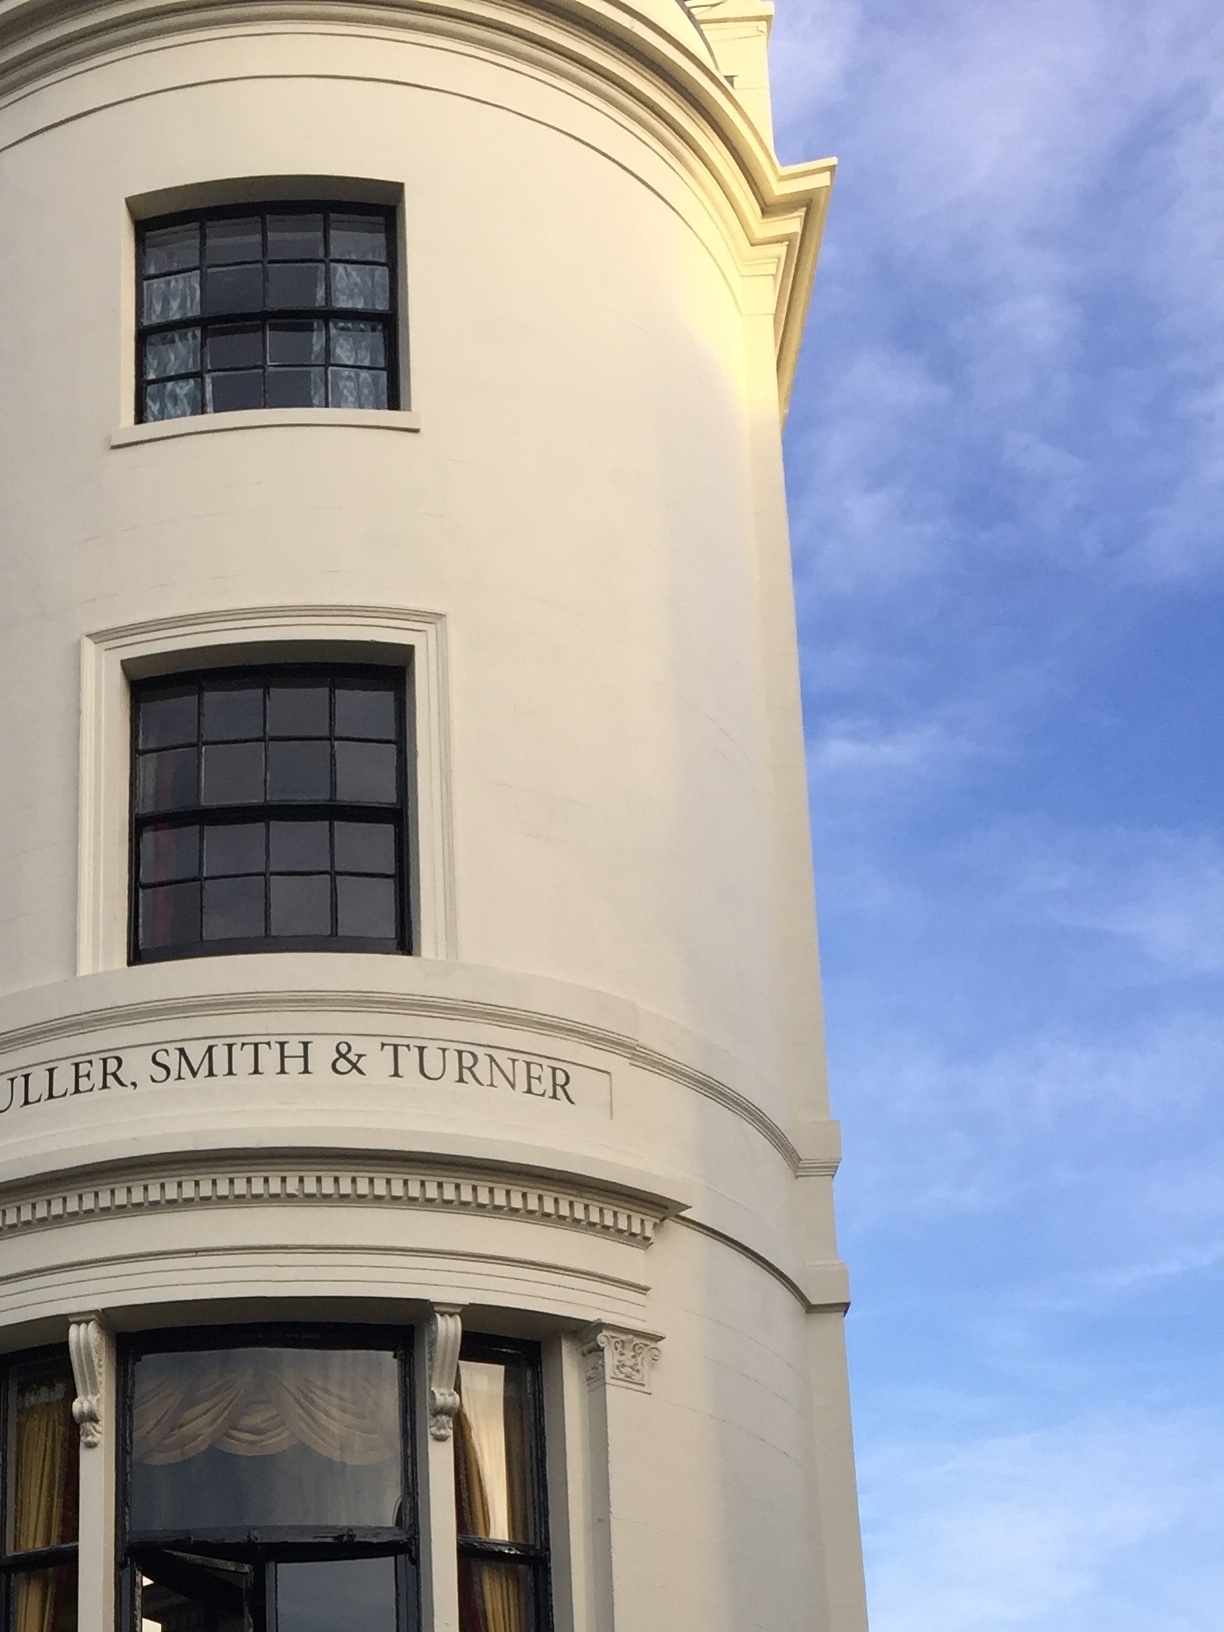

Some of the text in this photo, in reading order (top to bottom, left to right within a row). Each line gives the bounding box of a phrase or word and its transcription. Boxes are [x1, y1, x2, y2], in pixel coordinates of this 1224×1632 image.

[149, 1040, 313, 1084] SMITH
[331, 1041, 367, 1077] &
[381, 1042, 576, 1105] TURNER
